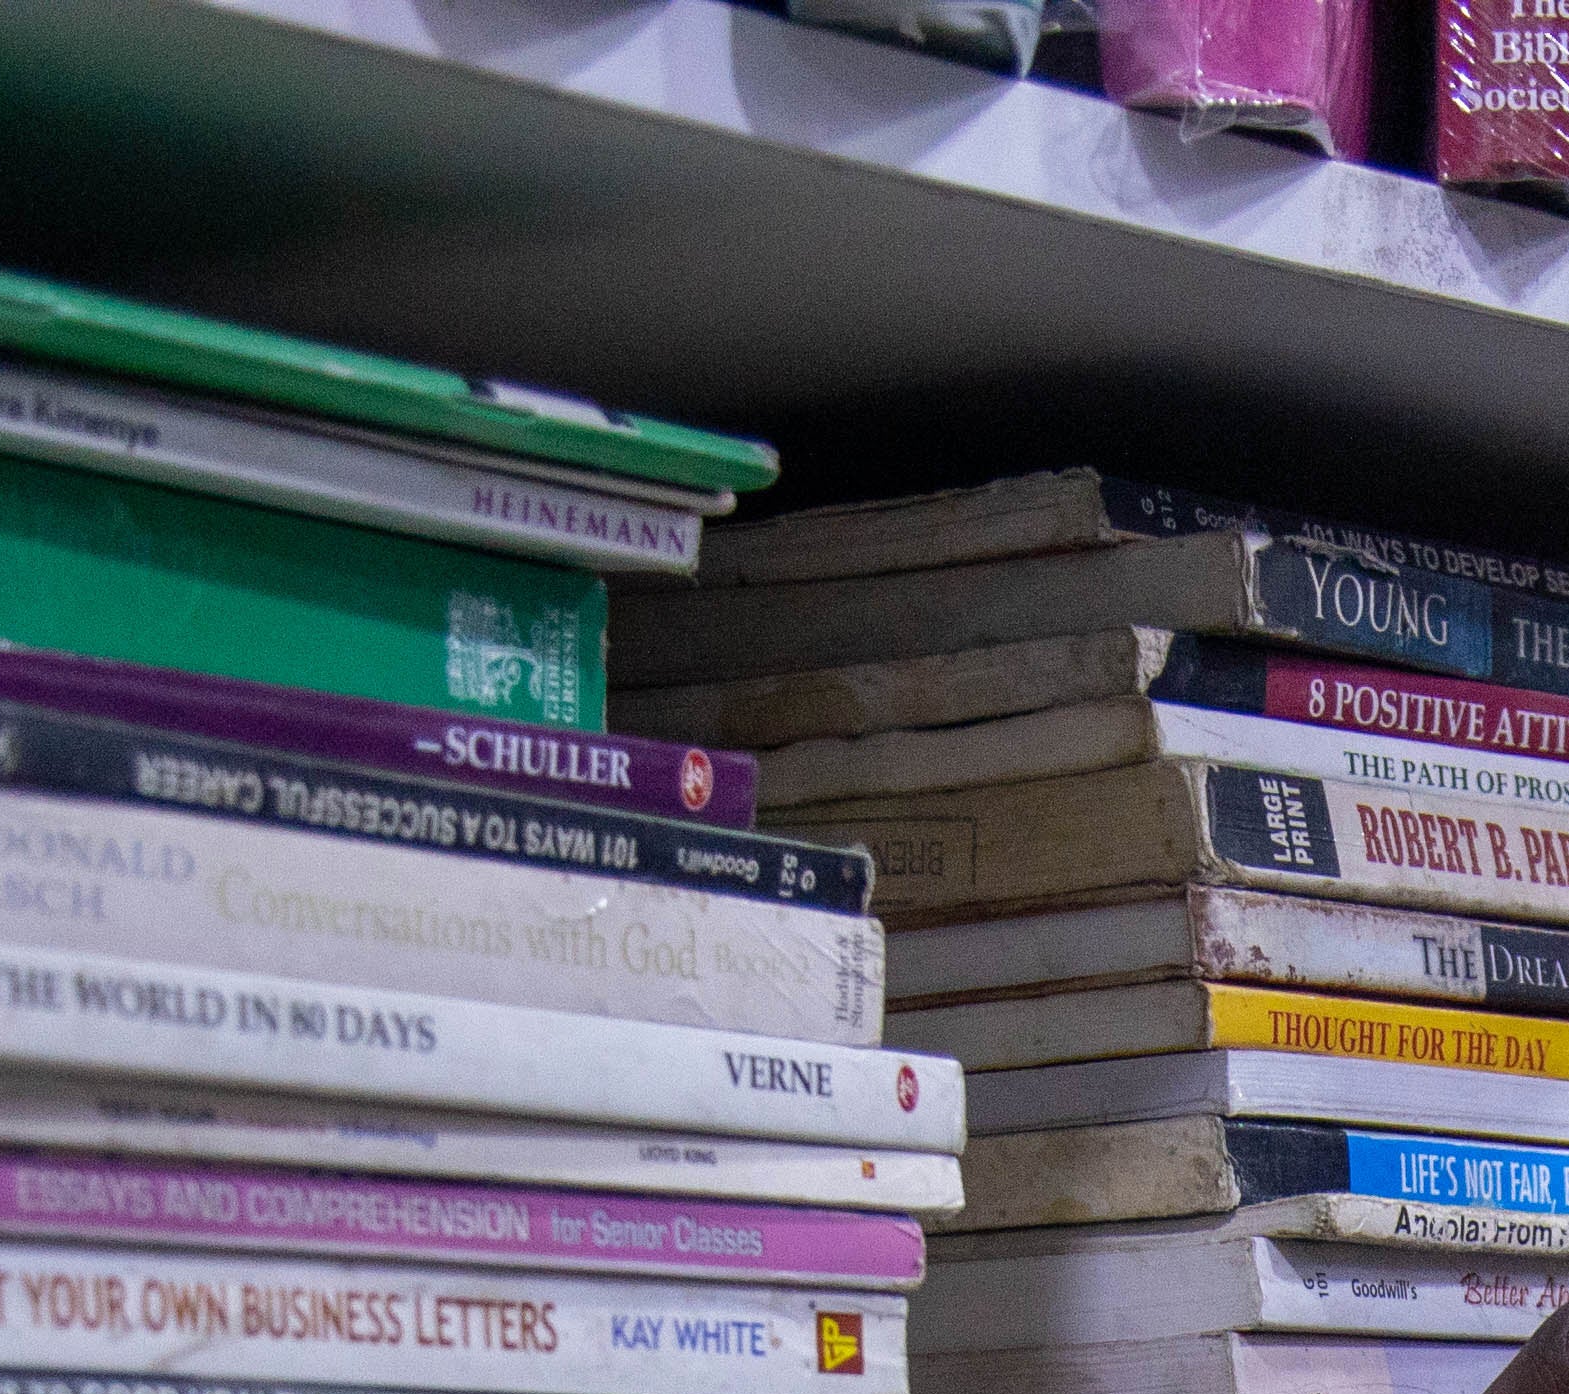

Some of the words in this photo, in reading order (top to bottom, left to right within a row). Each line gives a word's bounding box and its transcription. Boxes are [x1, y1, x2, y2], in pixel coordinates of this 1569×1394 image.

[474, 485, 689, 556] HEINEMANN
[1305, 557, 1449, 646] YOUNG
[1512, 618, 1569, 668] THE
[1308, 678, 1327, 718] 8
[1335, 680, 1485, 742] POSITIVE
[1343, 750, 1395, 782] THE
[1403, 760, 1469, 793] PATH
[1477, 770, 1510, 797] OF
[1259, 777, 1292, 863] LARGE
[1282, 780, 1314, 866] PRINT
[1357, 805, 1482, 877] ROBERT
[1486, 823, 1523, 882] B.
[337, 1010, 438, 1055] DAYS
[724, 1051, 832, 1100] VERNE
[1268, 1010, 1389, 1056] THOUGHT
[1397, 1025, 1443, 1060] FOR
[1452, 1029, 1497, 1065] THE
[1505, 1038, 1551, 1072] DAY
[1401, 1152, 1457, 1195] LIFE'S
[1464, 1158, 1503, 1200] NOT
[1511, 1165, 1556, 1211] FAIR,
[242, 1283, 402, 1348] BUSINESS
[413, 1296, 558, 1354] LETTERS
[612, 1316, 661, 1352] KAY
[676, 1316, 765, 1358] WHITE
[1352, 1279, 1417, 1301] Goodwill's
